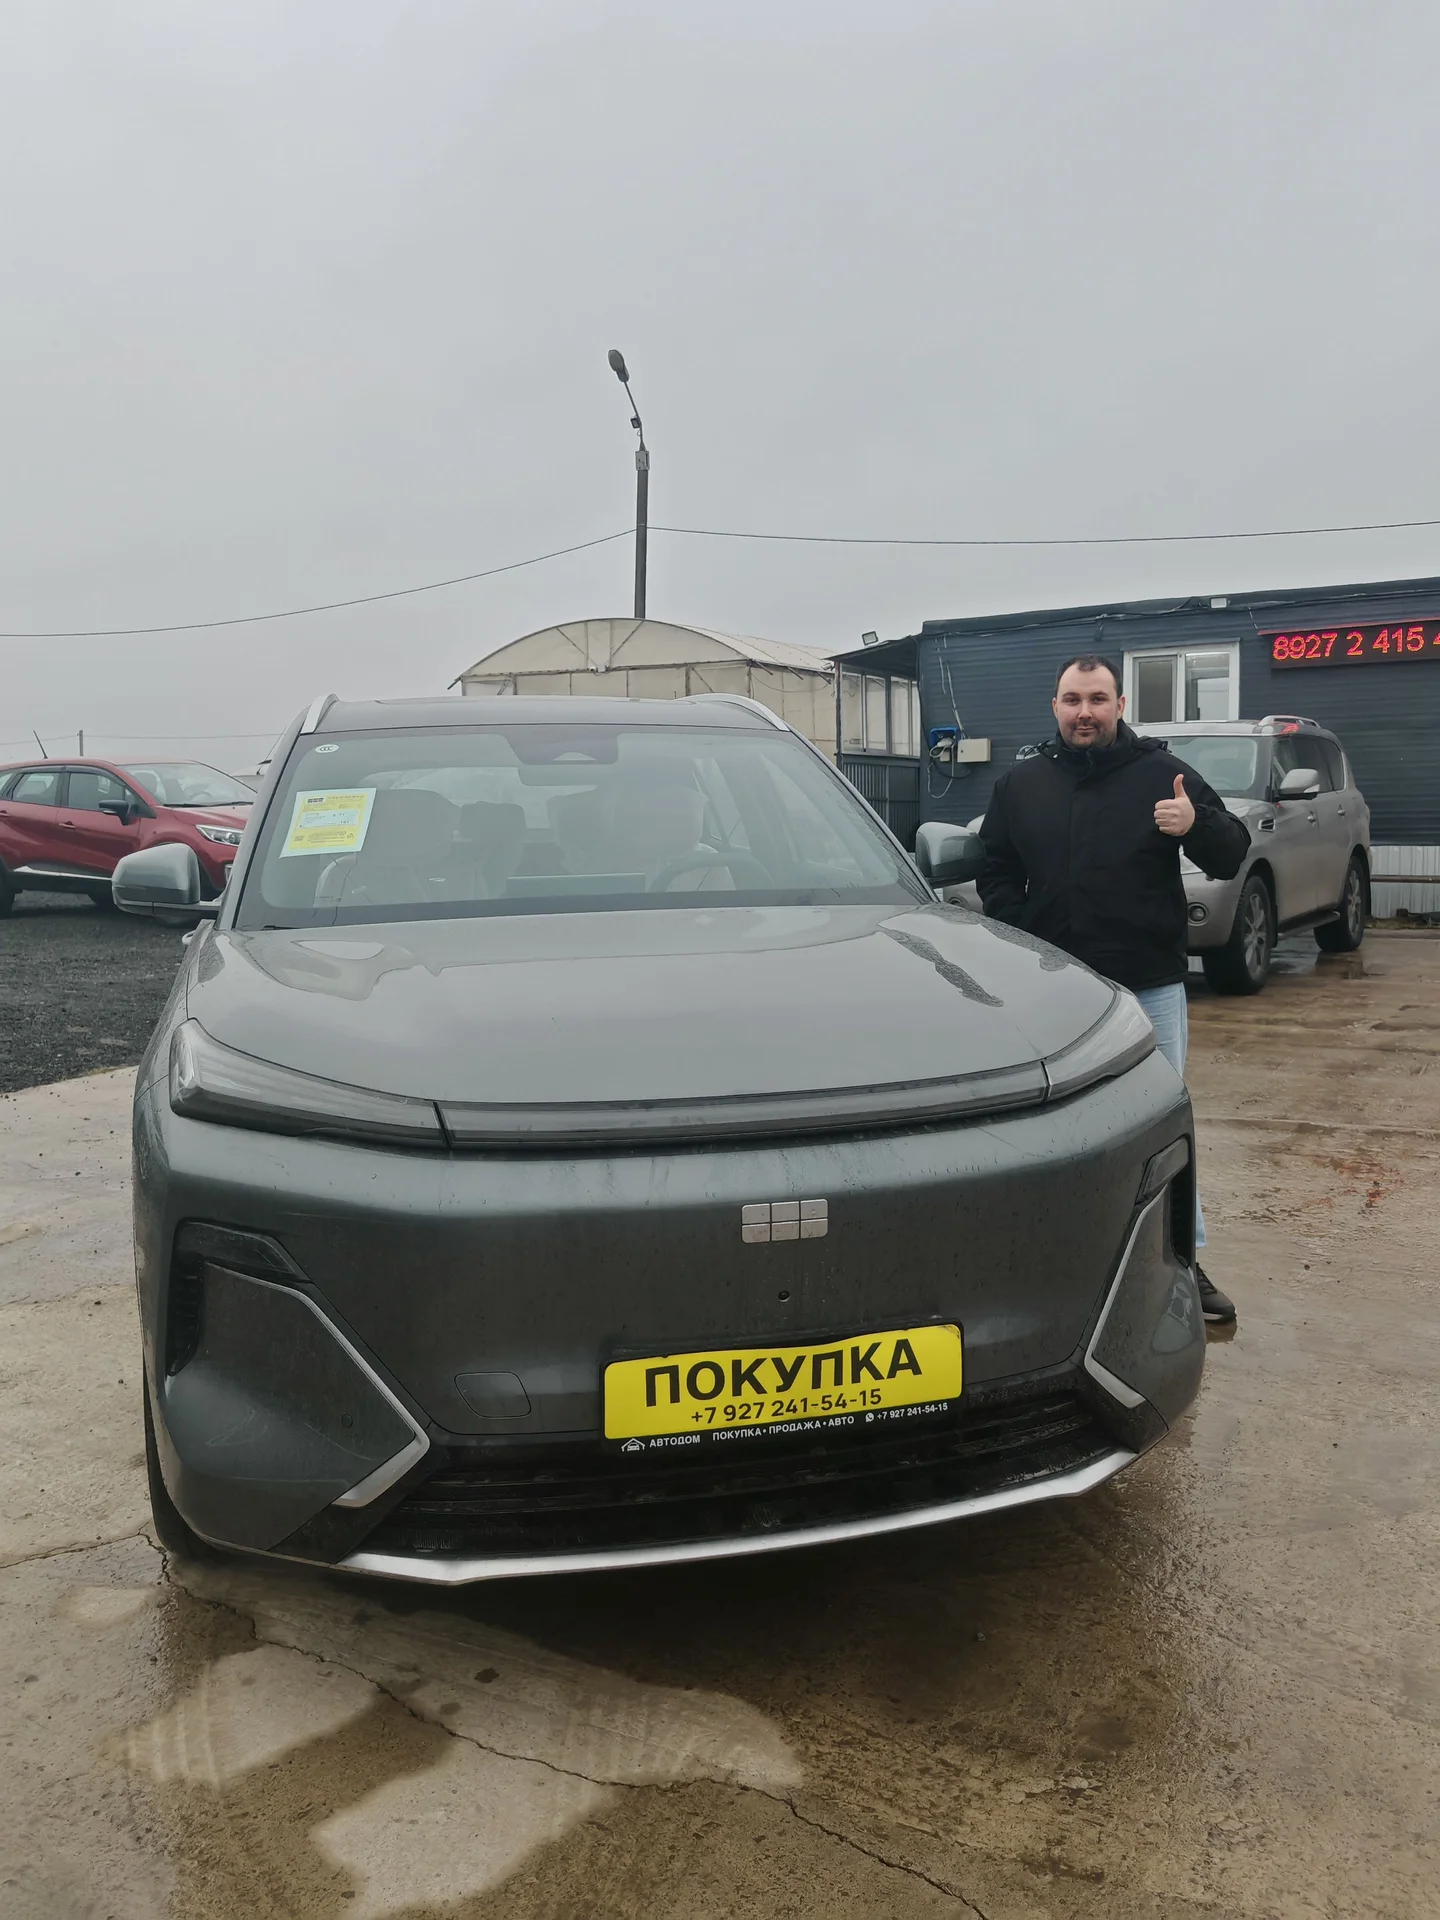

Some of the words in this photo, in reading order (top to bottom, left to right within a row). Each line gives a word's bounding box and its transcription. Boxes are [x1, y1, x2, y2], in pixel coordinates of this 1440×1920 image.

[1272, 631, 1338, 660] 8927
[1346, 630, 1364, 656] 2
[1372, 626, 1425, 654] 415
[645, 1338, 923, 1408] ПОКУПКА
[649, 1434, 701, 1448] АВТОДОМ
[712, 1427, 762, 1441] ПОКУПКА
[769, 1420, 822, 1435] ПРОДАЖА
[828, 1415, 855, 1428] АВТО
[877, 1409, 888, 1420] +7
[890, 1407, 905, 1419] 927
[907, 1402, 948, 1416] 241-54-15
[691, 1406, 717, 1424] +7
[723, 1401, 765, 1421] 927
[771, 1388, 882, 1417] 241-54-15
